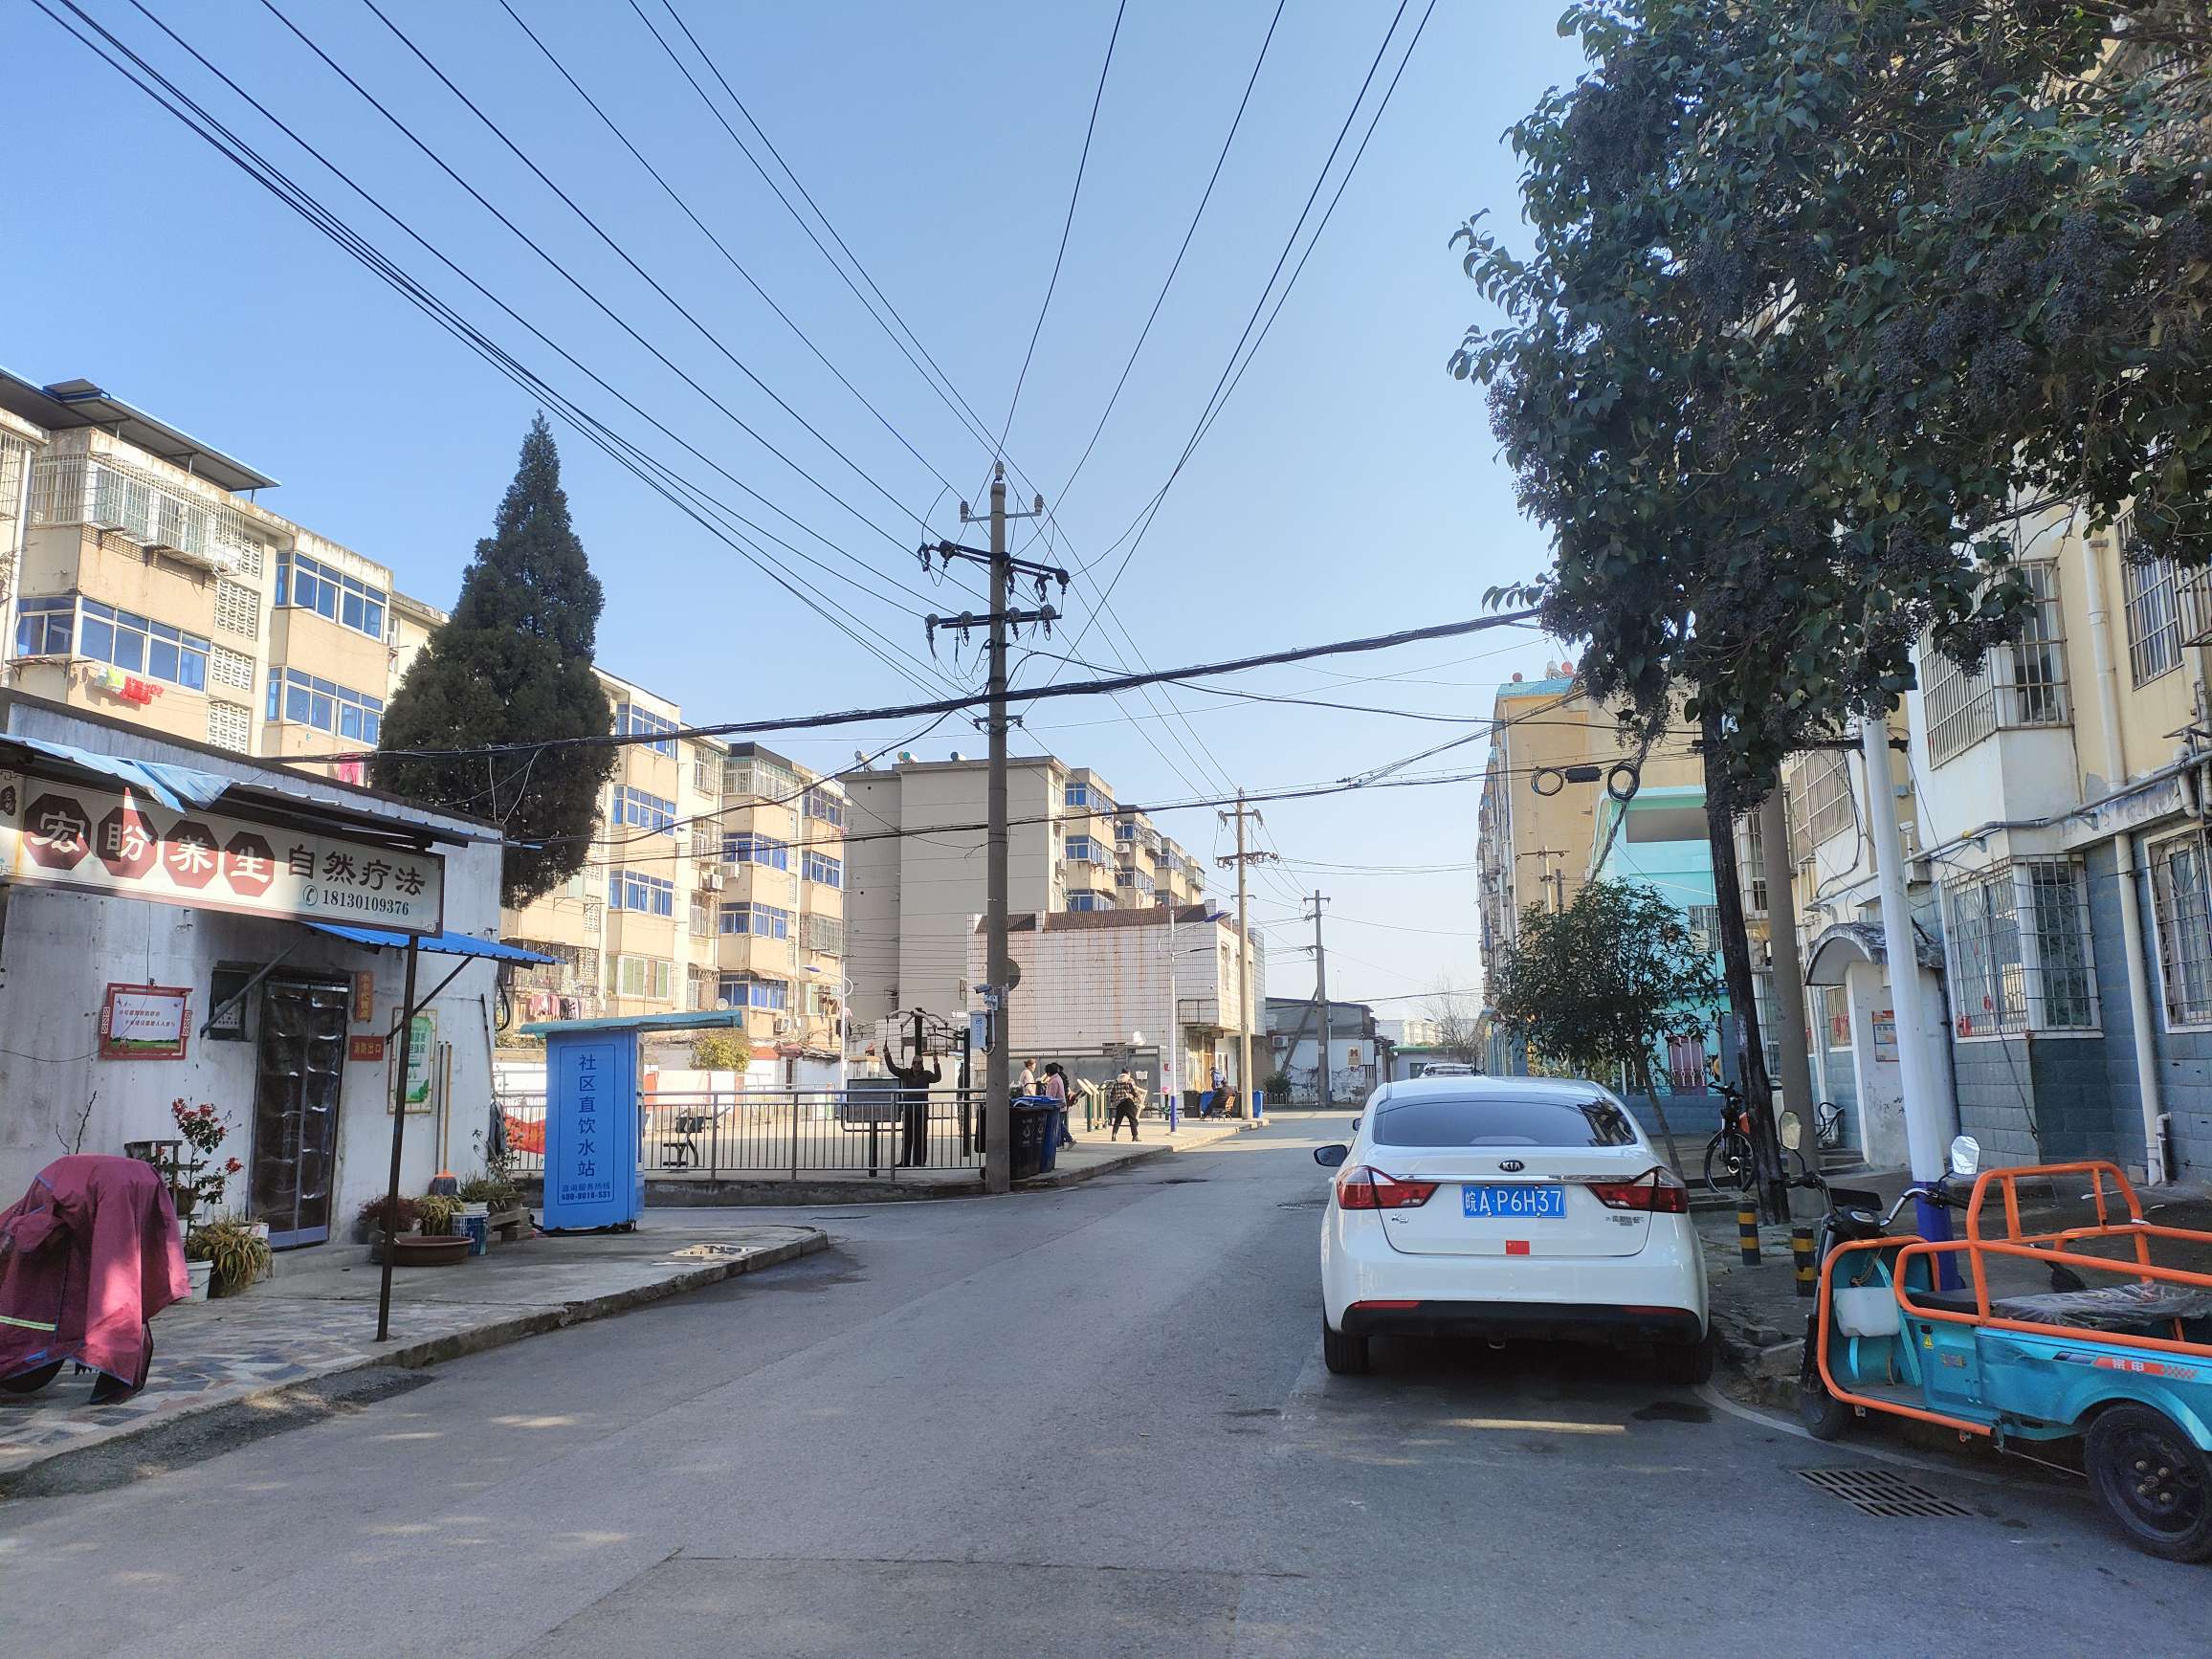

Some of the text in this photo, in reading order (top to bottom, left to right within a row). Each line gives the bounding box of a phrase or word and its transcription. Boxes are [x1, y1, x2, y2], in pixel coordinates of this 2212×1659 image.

[30, 811, 272, 884] 宏盼养生
[288, 844, 426, 896] 自然疗法
[322, 889, 409, 916] 18130109376
[577, 1053, 597, 1177] 社区直饮水站
[1502, 1161, 1520, 1170] KIA
